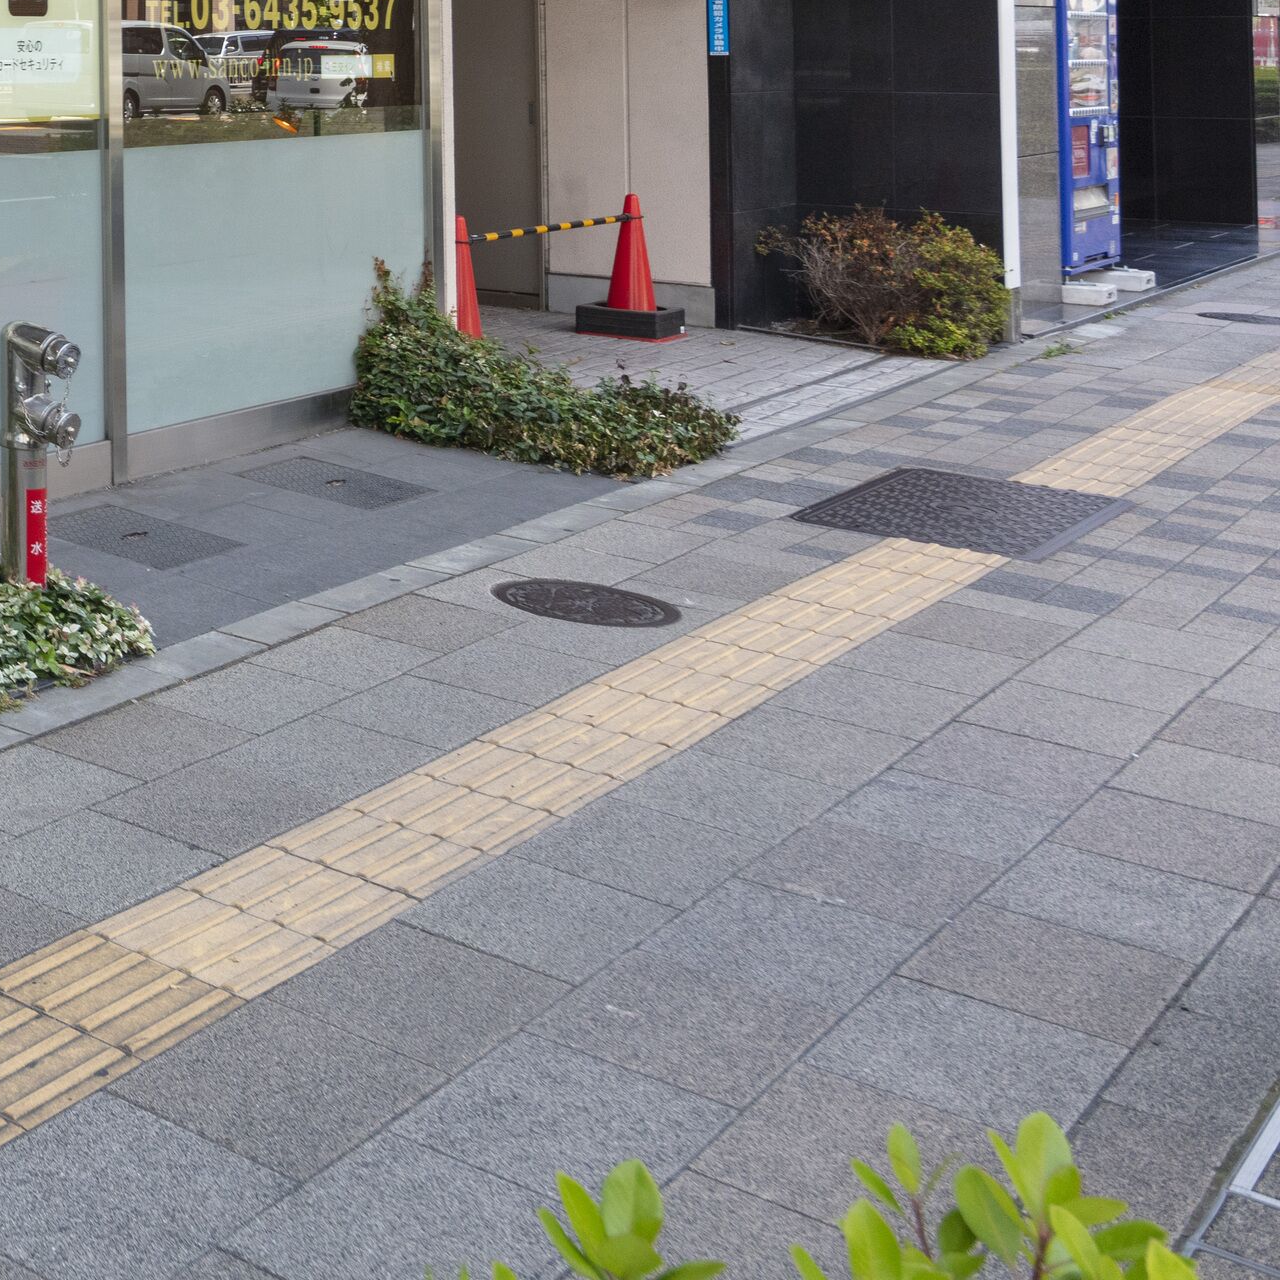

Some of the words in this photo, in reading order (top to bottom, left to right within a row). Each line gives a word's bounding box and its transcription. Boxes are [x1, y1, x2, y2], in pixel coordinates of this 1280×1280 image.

[17, 40, 42, 53] 安心の
[153, 49, 314, 82] www.sanco-inn.jp
